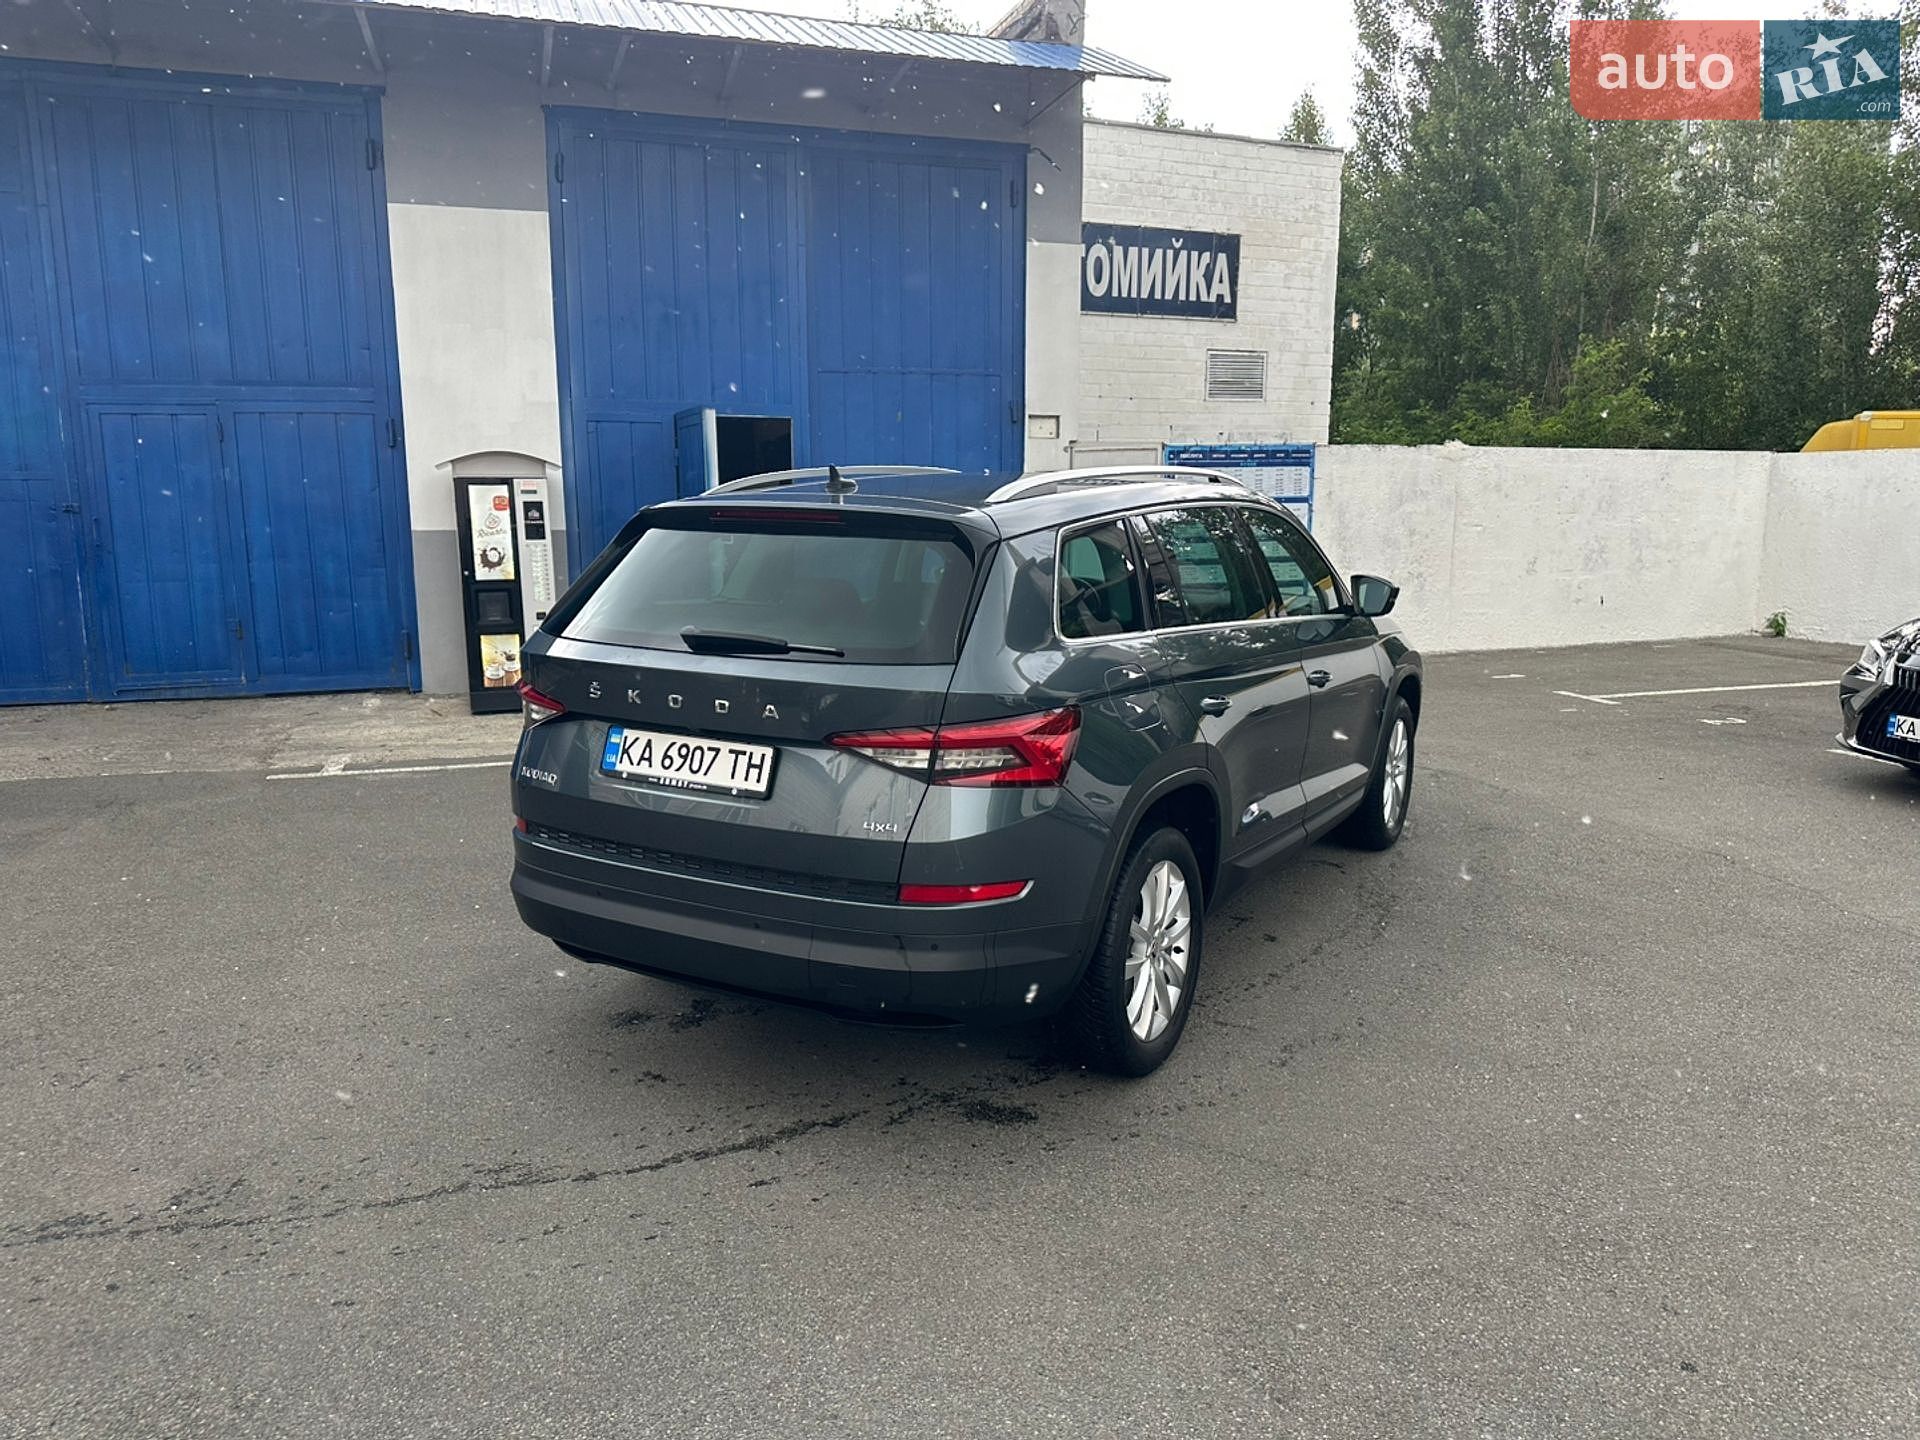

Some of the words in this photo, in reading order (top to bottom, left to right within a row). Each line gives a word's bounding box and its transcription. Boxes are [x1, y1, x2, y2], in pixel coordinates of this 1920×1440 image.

[589, 681, 780, 720] ŠKODA
[1896, 718, 1916, 735] KA
[618, 735, 653, 768] KA
[660, 741, 721, 777] 6907
[728, 748, 767, 784] TH
